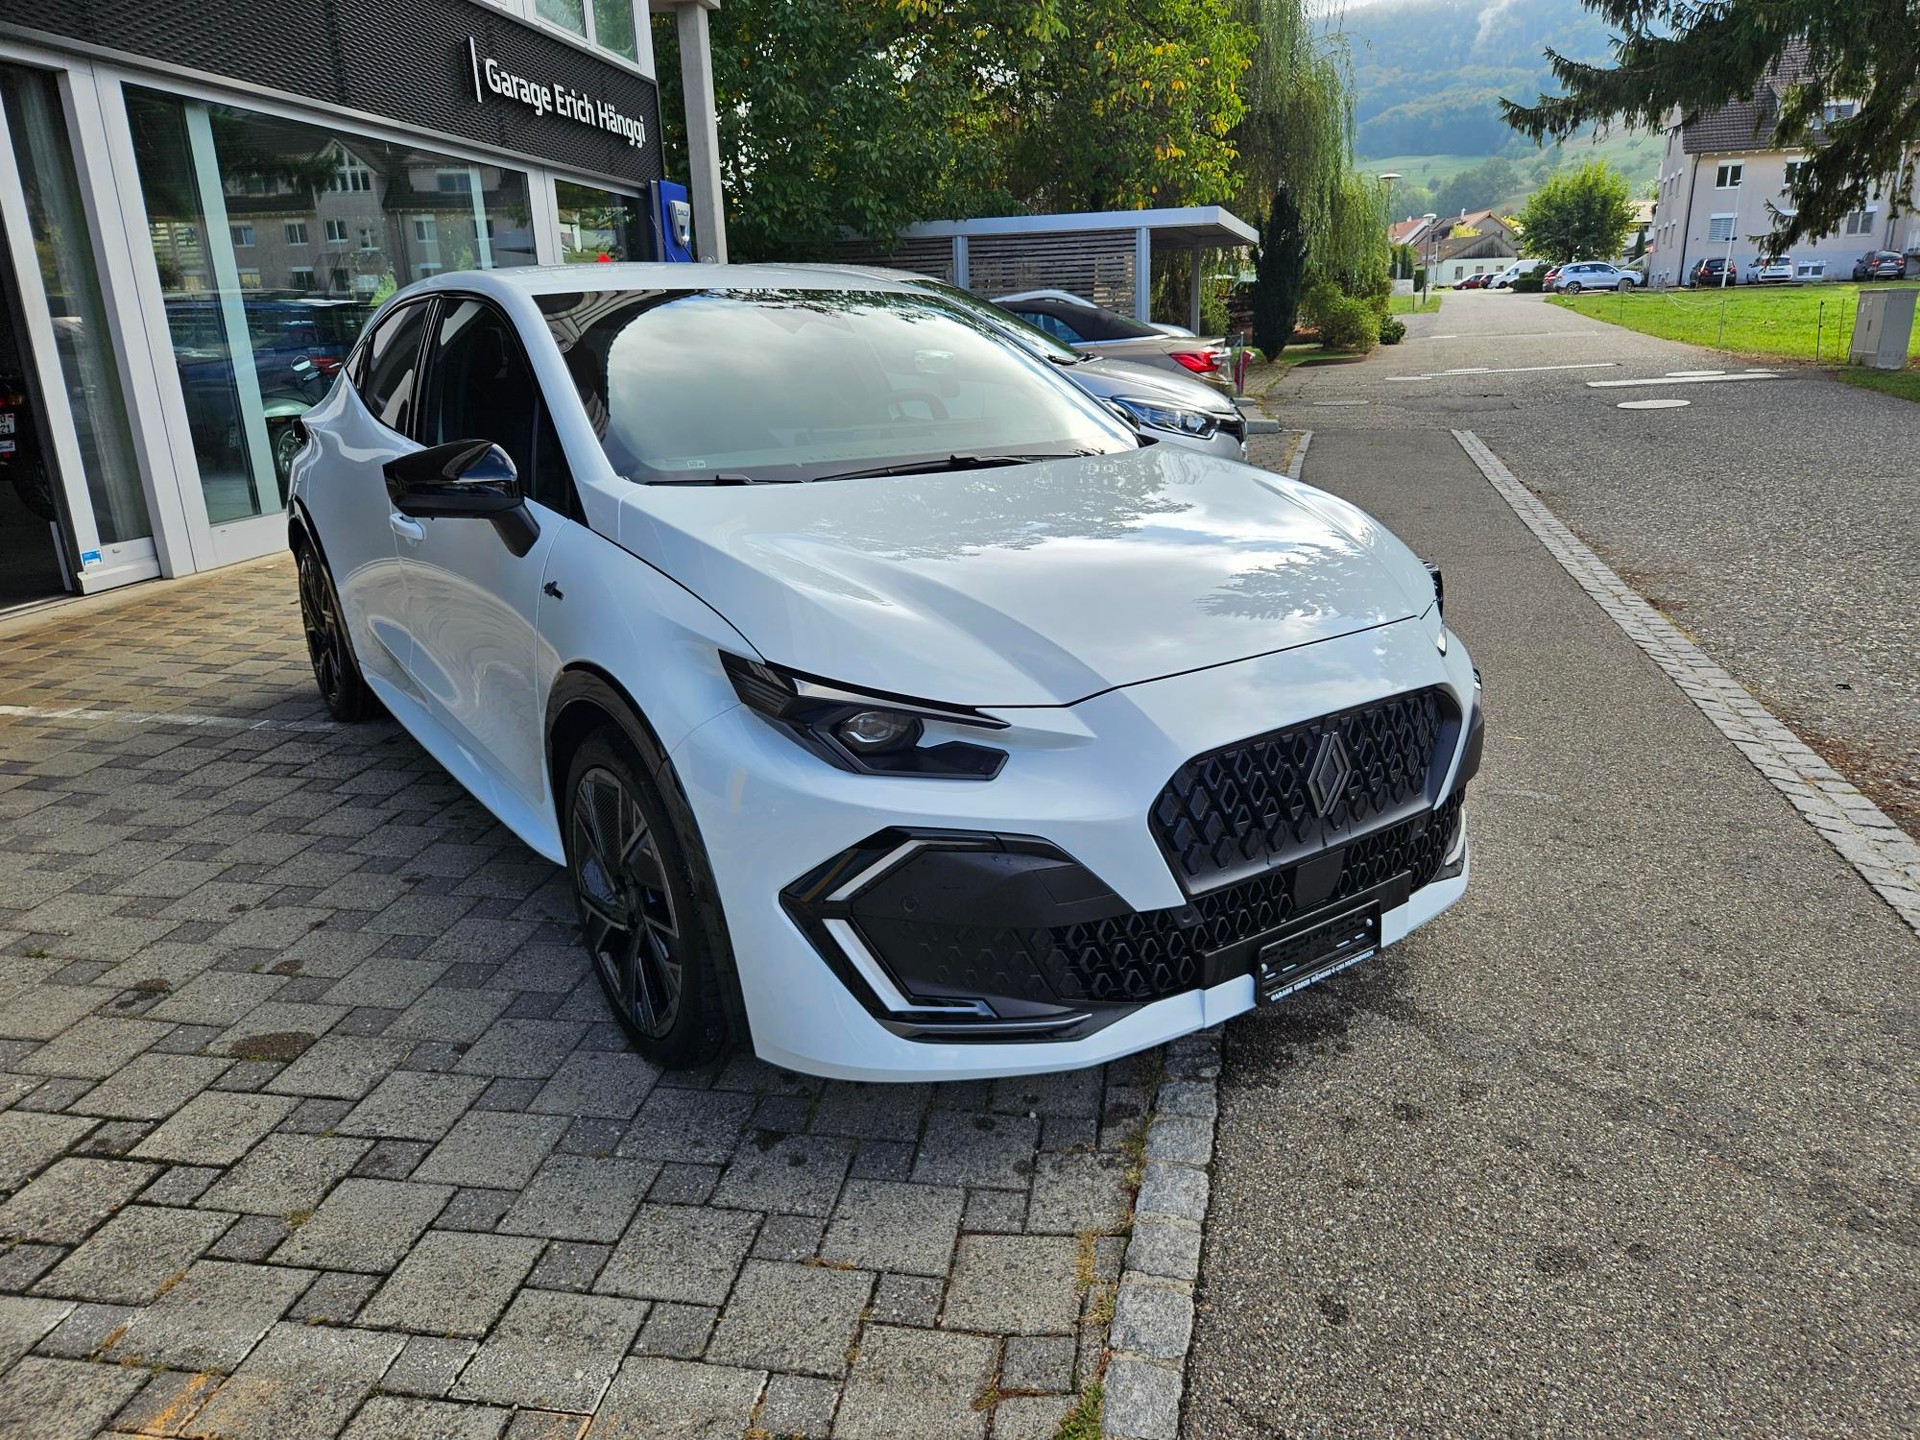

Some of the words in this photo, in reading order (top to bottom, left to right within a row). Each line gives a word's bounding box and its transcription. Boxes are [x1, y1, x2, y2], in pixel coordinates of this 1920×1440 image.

[485, 58, 552, 116] Garage
[553, 83, 596, 126] Erich
[596, 99, 646, 149] Hänggi
